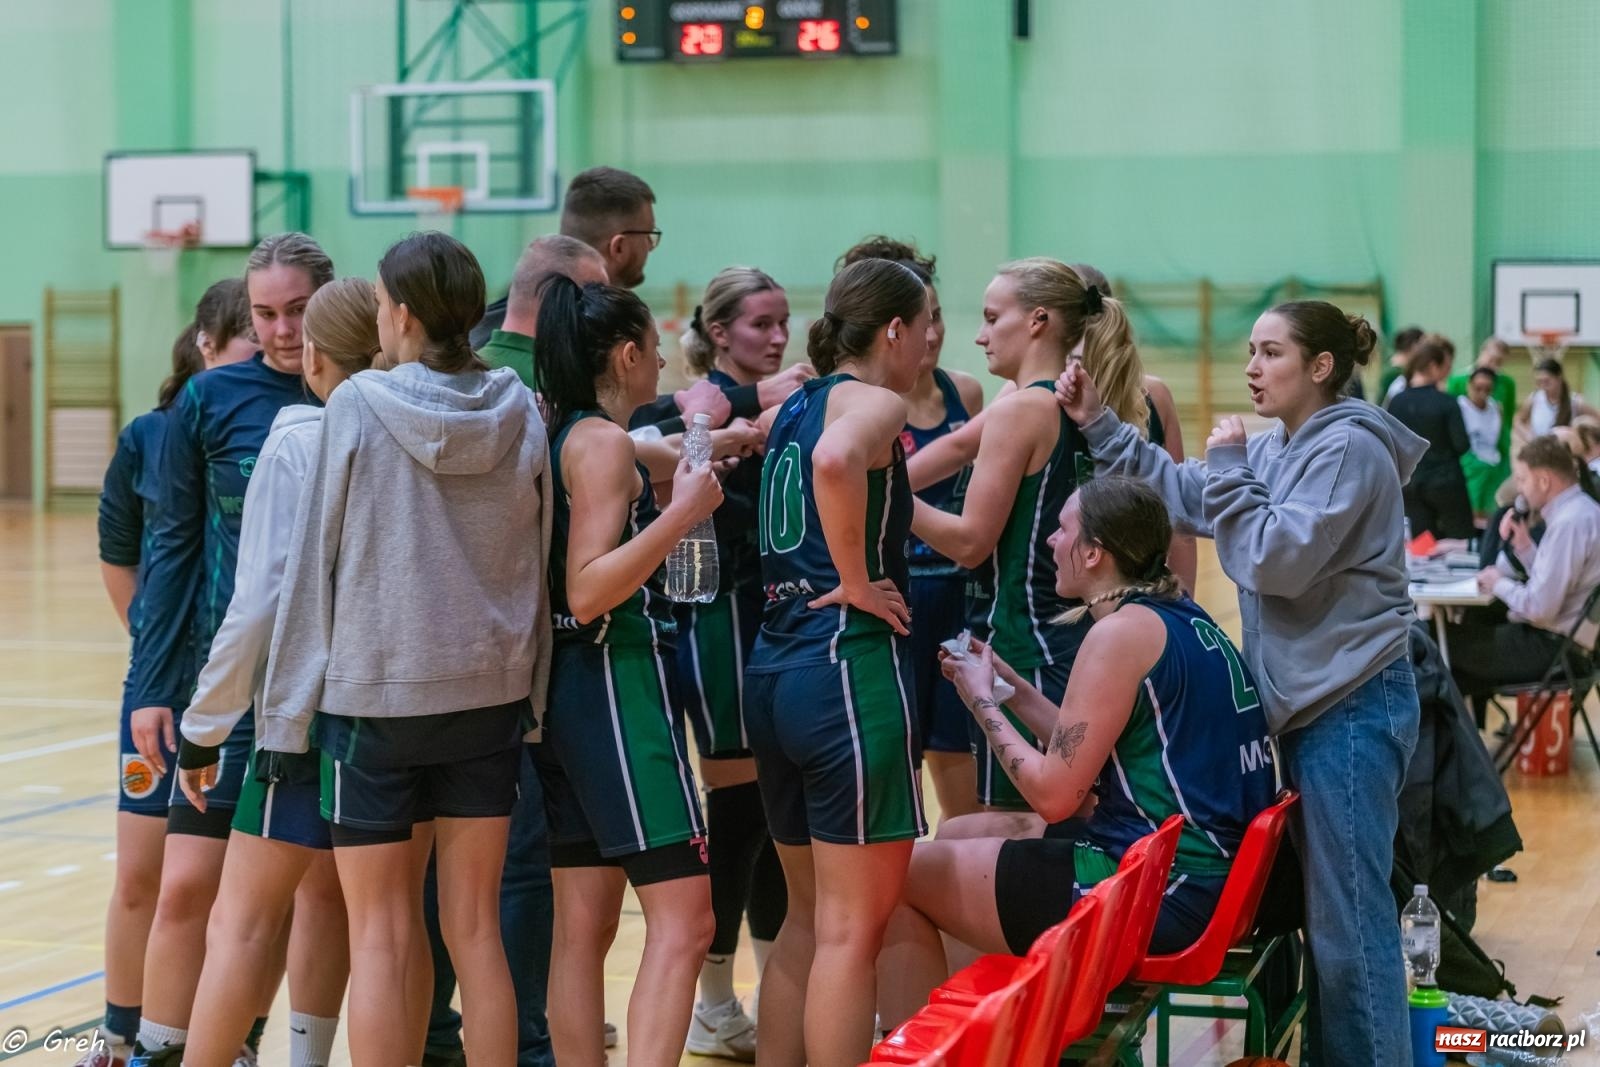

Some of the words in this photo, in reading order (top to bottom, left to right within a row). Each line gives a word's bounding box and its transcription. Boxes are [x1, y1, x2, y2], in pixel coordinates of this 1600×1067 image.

[798, 20, 840, 51] 26
[759, 441, 806, 556] 10
[1546, 702, 1564, 756] 5
